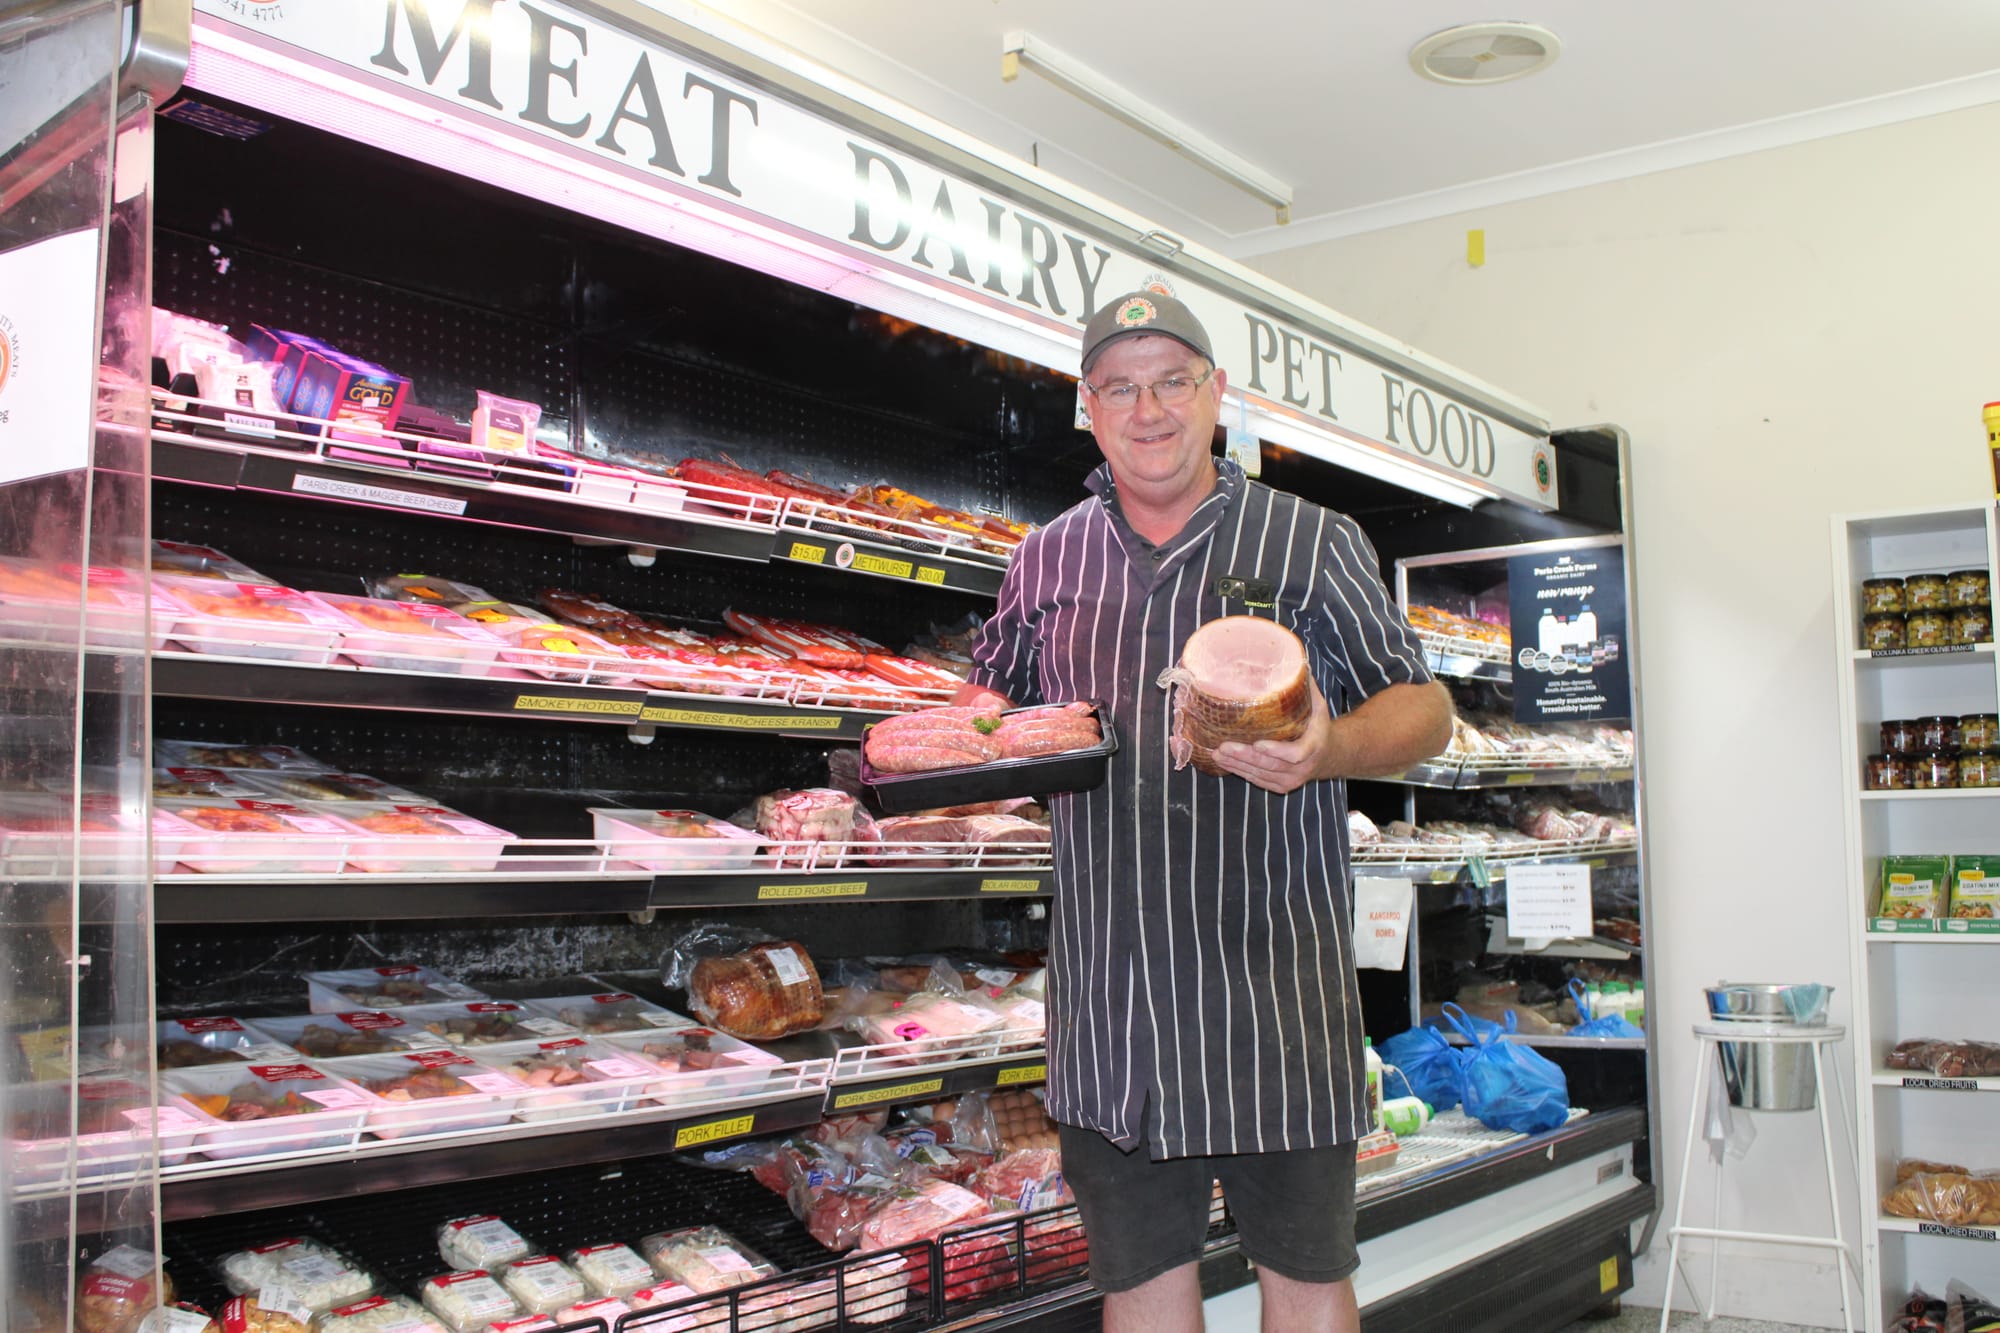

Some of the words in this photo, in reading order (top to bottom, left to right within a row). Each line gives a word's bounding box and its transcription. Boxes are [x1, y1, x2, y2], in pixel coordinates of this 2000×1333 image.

[253, 5, 285, 21] 4777
[370, 0, 758, 197] MEAT
[846, 141, 1111, 326] DAIRY
[1244, 312, 1342, 420] PET
[1382, 373, 1495, 478] FOOD
[302, 478, 329, 489] PARIS
[330, 482, 359, 495] CREEK
[369, 489, 401, 502] MAGGIE
[403, 495, 426, 505] BEER
[427, 498, 460, 511] CHEESE
[791, 546, 824, 561] $15.00
[853, 555, 911, 576] METTWURST
[917, 570, 944, 583] $30.00
[1537, 588, 1560, 599] new
[1560, 585, 1595, 601] range
[1930, 645, 1950, 653] OLIVE
[1951, 643, 1974, 651] RANGE
[517, 697, 574, 709] SMOKEY
[576, 700, 640, 713] HOTDOGS
[1536, 698, 1566, 706] Honestly
[642, 709, 678, 720] CHILLI
[680, 712, 727, 724] CHEESE
[728, 716, 747, 726] KR
[745, 717, 790, 727] CHEESE
[791, 717, 840, 727] KRANSKY
[760, 887, 802, 897] ROLLED
[804, 885, 839, 895] ROAST
[840, 883, 865, 893] BEEF
[1010, 881, 1038, 889] ROAST
[997, 1071, 1022, 1082] PORK
[1023, 1067, 1046, 1080] BELL
[1904, 1079, 1927, 1087] LOCAL
[1928, 1080, 1951, 1088] DRIED
[1951, 1080, 1977, 1089] FRUITS
[837, 1095, 865, 1105] PORK
[867, 1088, 910, 1101] SCOTCH
[910, 1080, 941, 1093] ROAST
[678, 1126, 710, 1145] PORK
[713, 1117, 752, 1137] FILLET
[1921, 1224, 1944, 1234] LOCAL
[1945, 1226, 1968, 1237] DRIED
[1968, 1229, 1995, 1240] FRUITS
